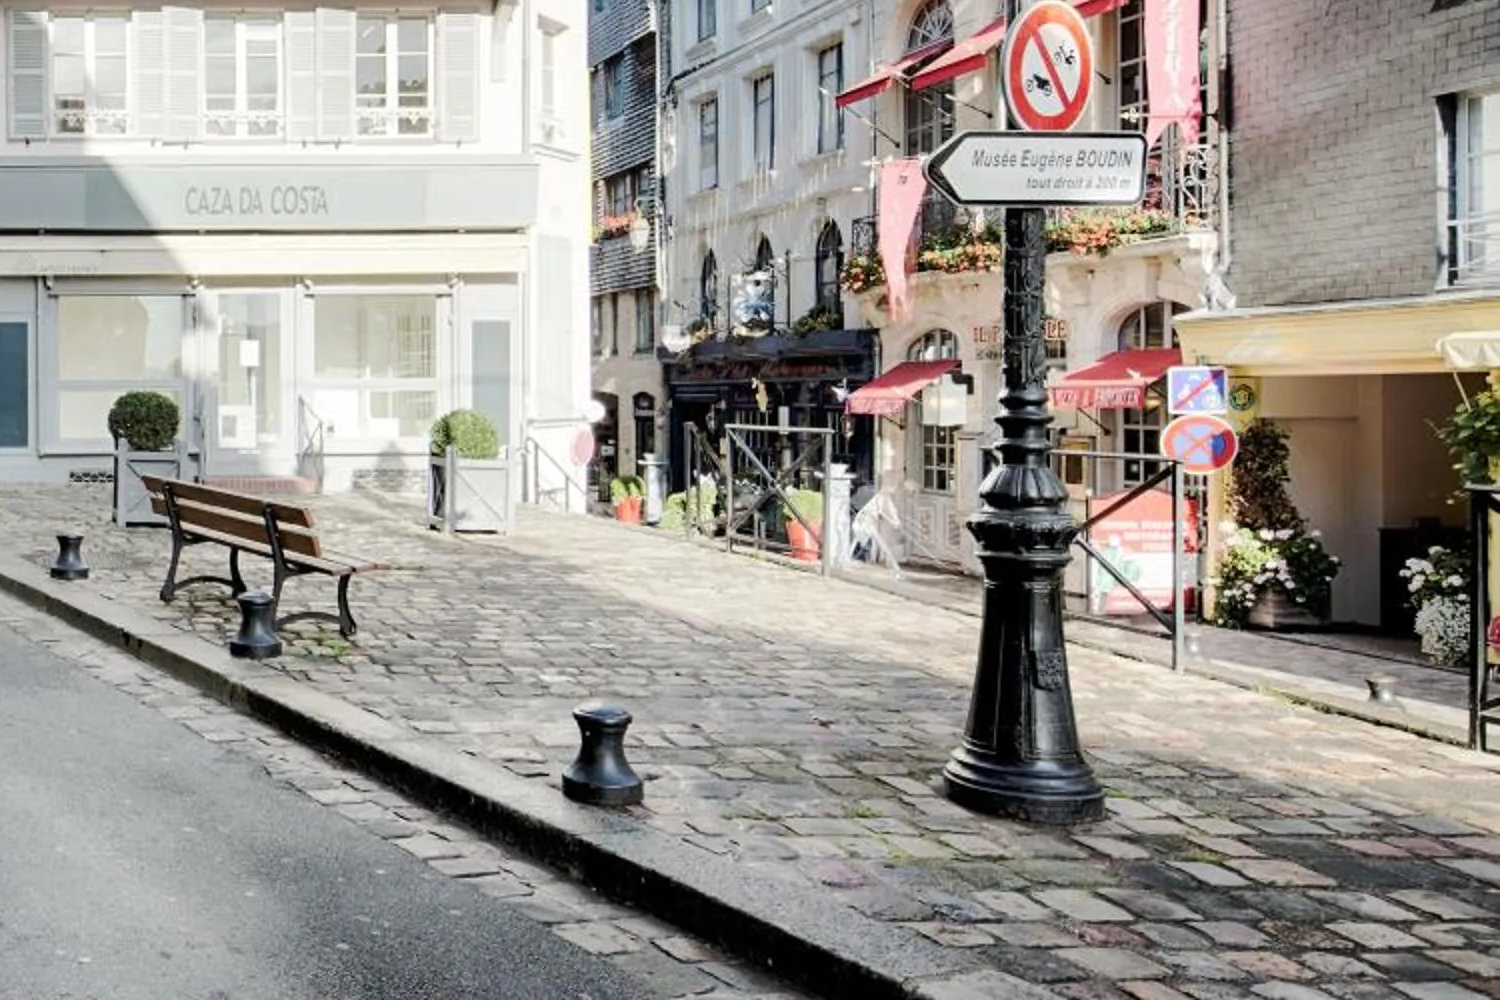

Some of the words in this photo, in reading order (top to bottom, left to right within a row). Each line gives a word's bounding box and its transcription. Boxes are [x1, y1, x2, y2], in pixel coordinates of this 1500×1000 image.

[972, 149, 1017, 168] Musée
[1020, 149, 1073, 172] Eugène
[1075, 149, 1133, 168] BOUDIN
[1026, 176, 1051, 189] tout
[1053, 176, 1083, 189] droit
[185, 186, 234, 215] CAZA
[239, 186, 263, 214] DA
[270, 185, 329, 215] COSTA
